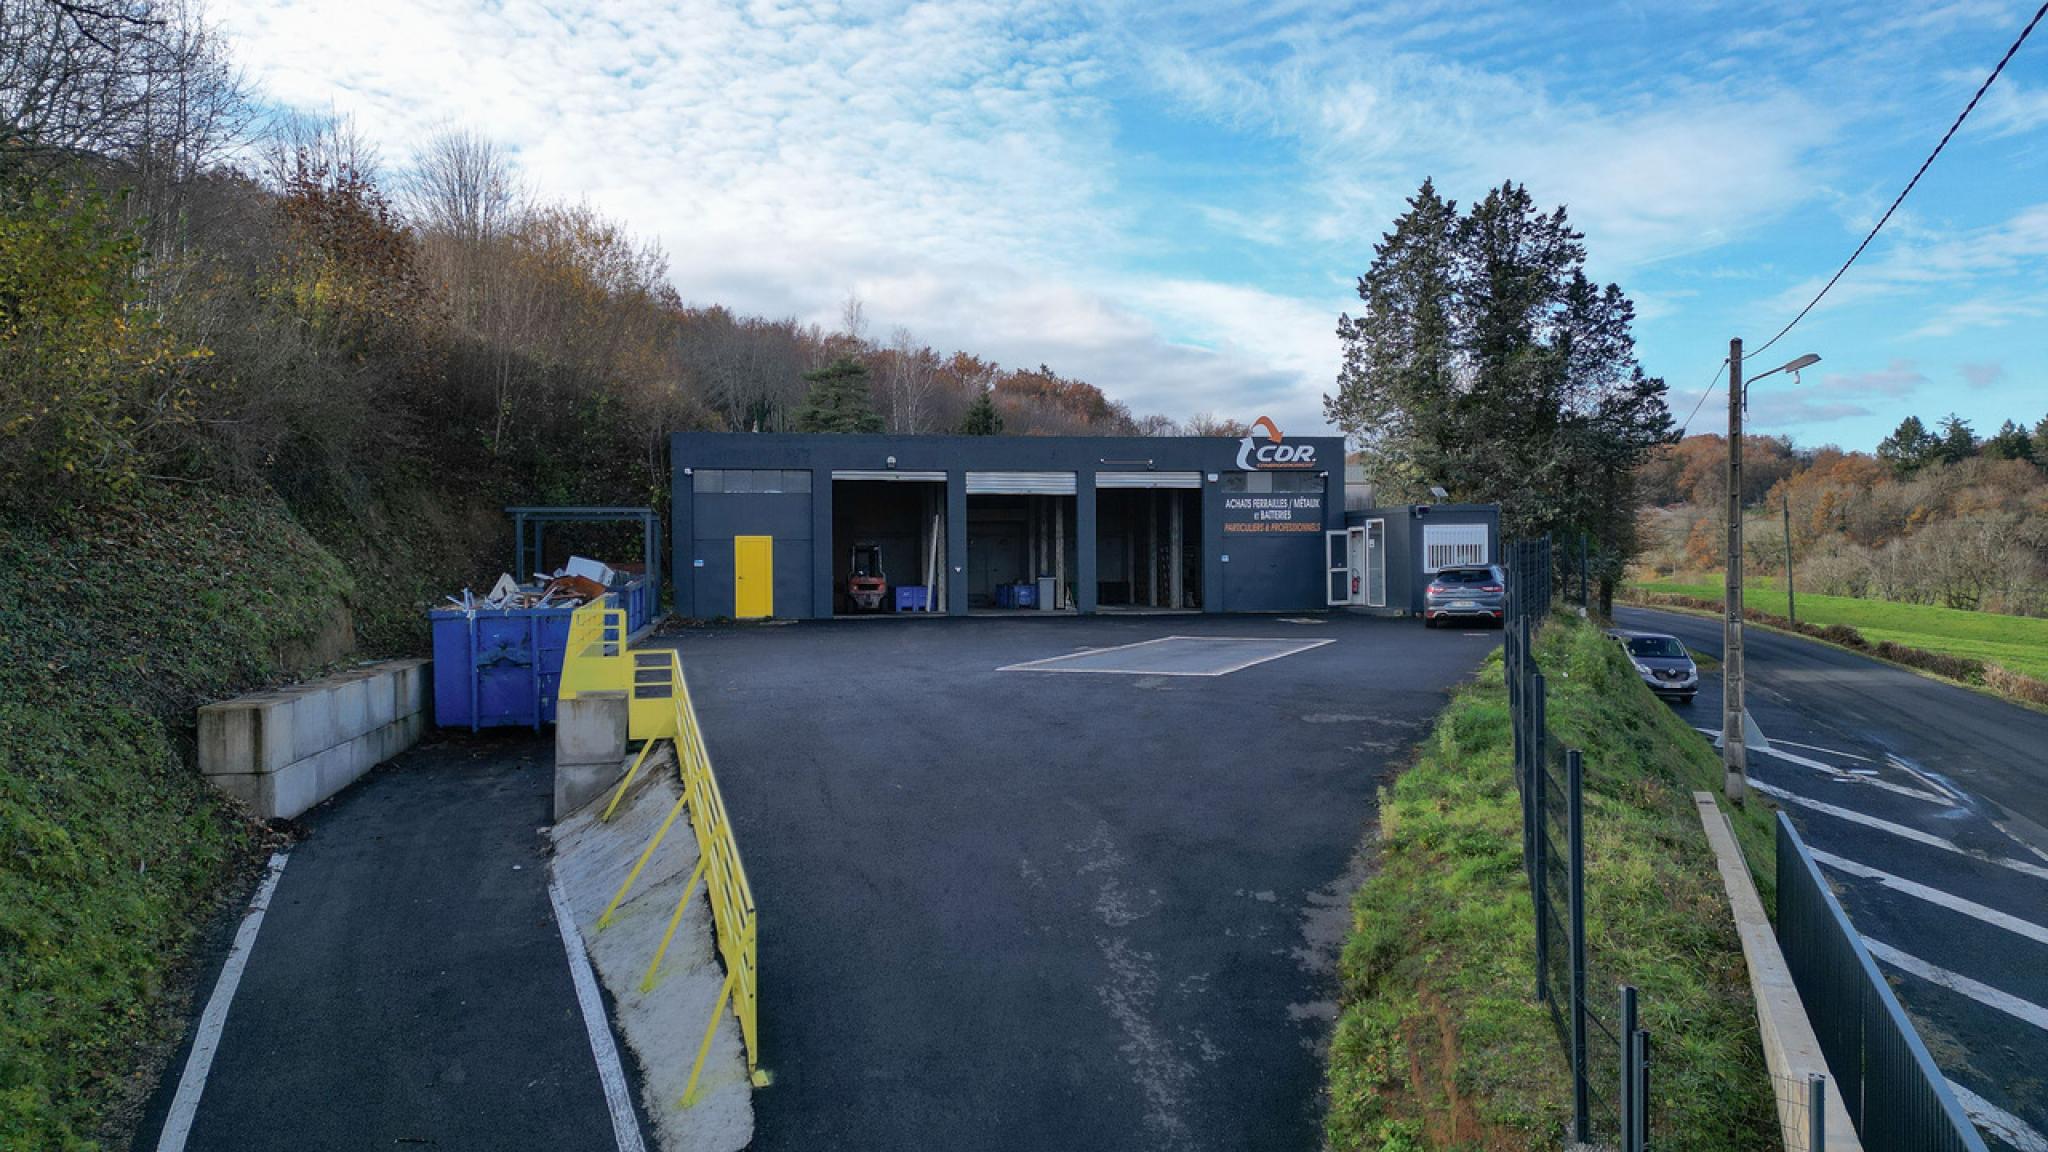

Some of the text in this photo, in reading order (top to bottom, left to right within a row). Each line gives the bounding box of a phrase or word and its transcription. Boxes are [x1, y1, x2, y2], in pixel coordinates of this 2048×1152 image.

[1225, 498, 1251, 508] ACHATS
[1252, 498, 1288, 508] FERRAILLES
[1294, 496, 1320, 508] MÉTAUX
[1260, 510, 1292, 520] BATTERIES
[1224, 523, 1265, 532] PARTICULIERS
[1271, 523, 1320, 532] PROFESSIONNELS
